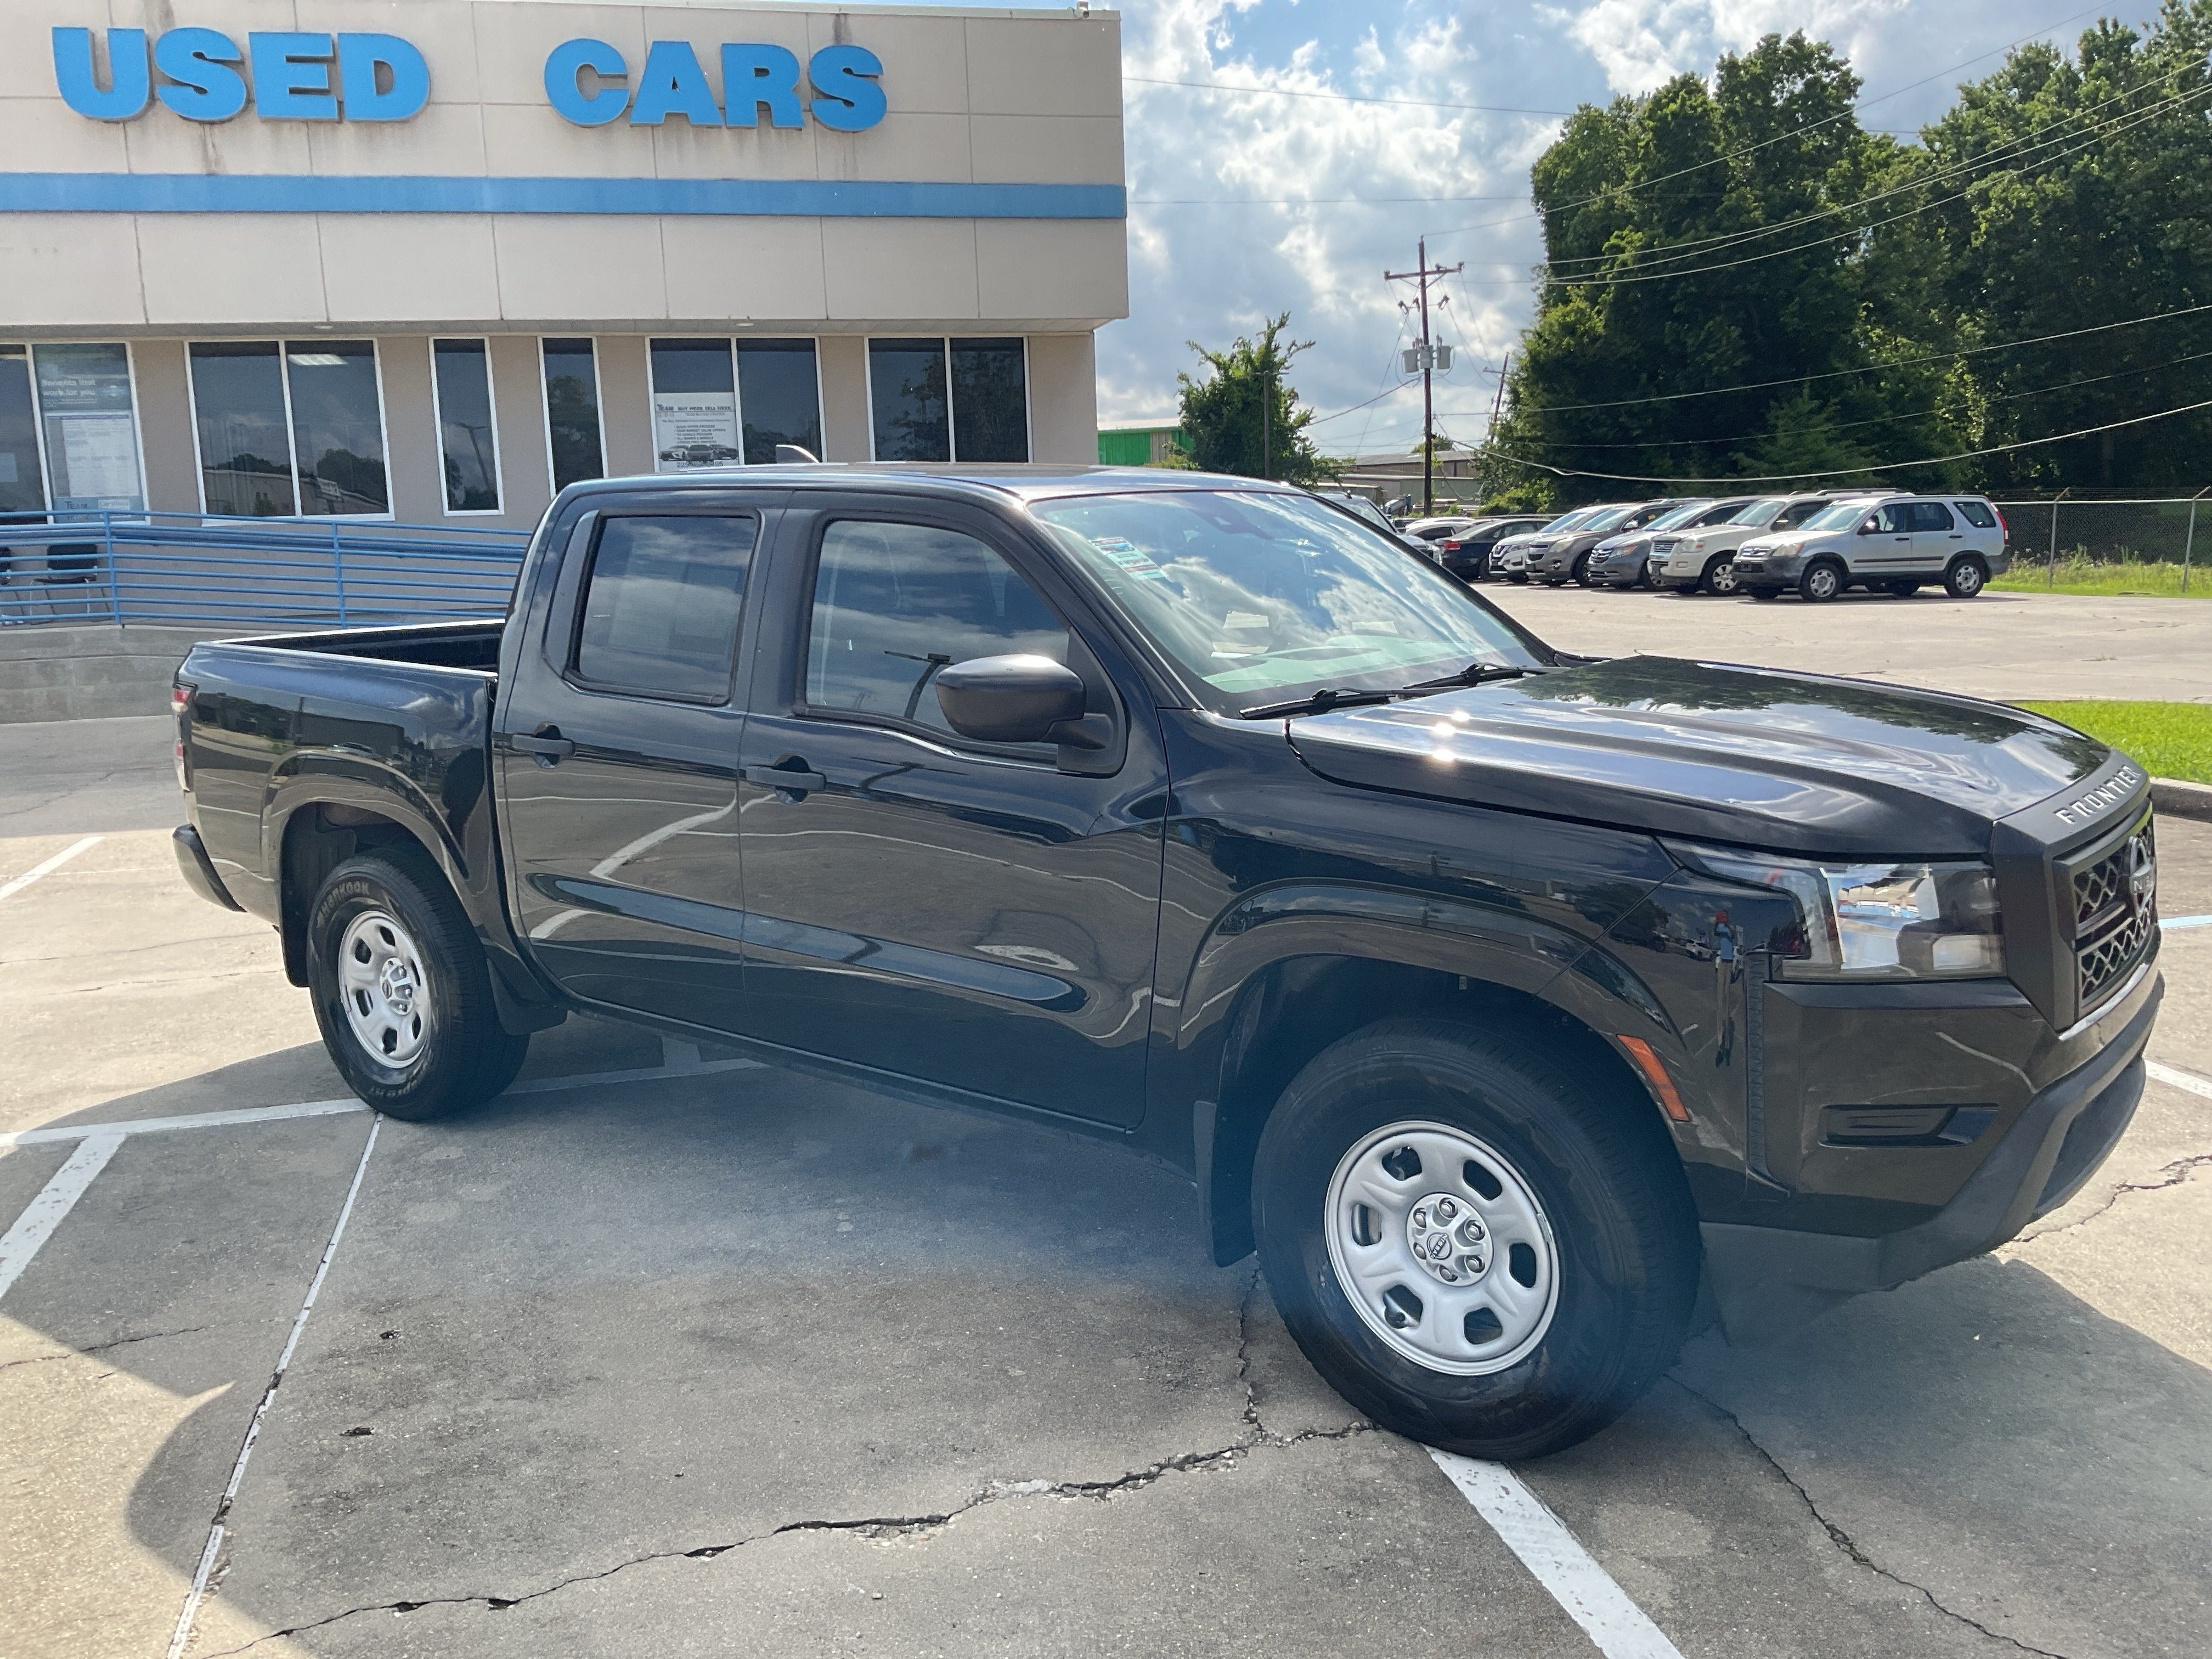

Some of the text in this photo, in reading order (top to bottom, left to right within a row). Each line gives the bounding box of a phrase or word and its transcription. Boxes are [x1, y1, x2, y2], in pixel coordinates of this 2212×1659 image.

[52, 27, 888, 132] USED CARS
[2055, 765, 2142, 825] FRONTIER
[1430, 1233, 1448, 1260] NISSAN
